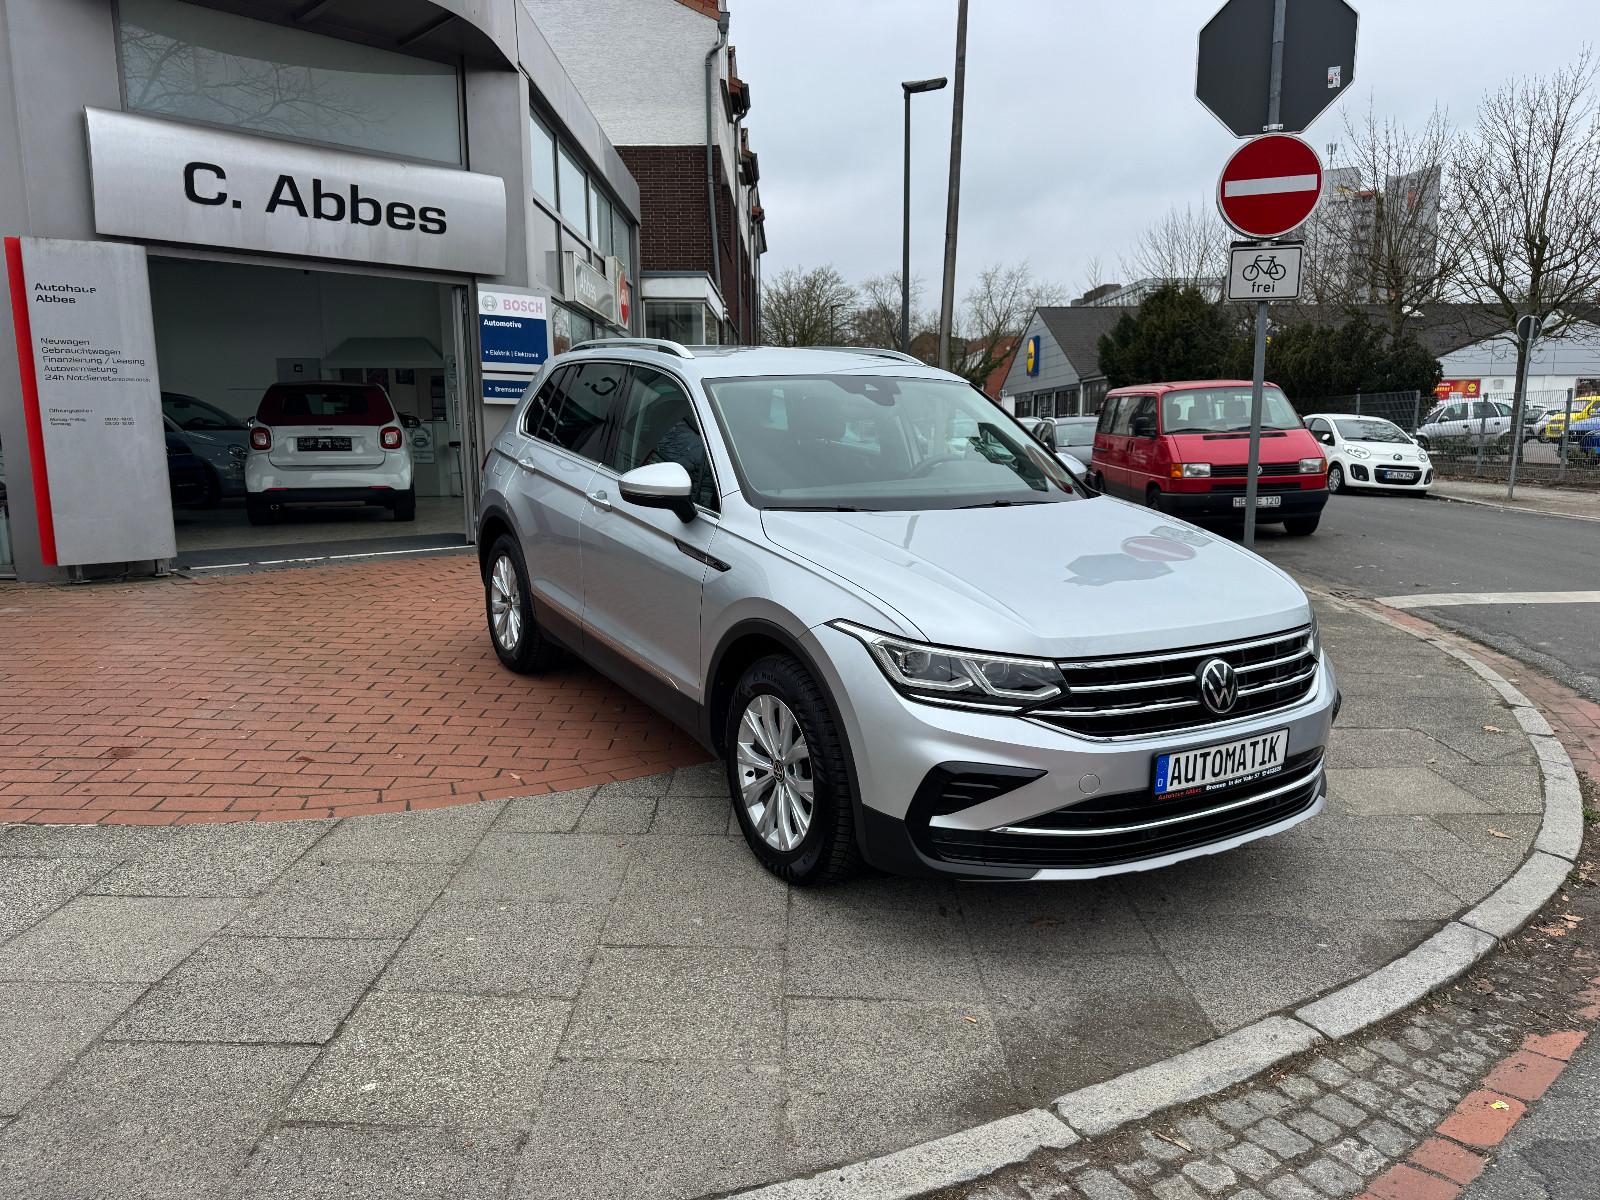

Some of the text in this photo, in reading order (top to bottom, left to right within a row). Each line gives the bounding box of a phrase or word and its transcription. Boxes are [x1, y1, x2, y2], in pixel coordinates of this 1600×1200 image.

[184, 162, 447, 234] C. Abbes
[1252, 281, 1275, 293] frei
[35, 294, 76, 304] Abbes
[503, 299, 543, 313] BOSCH
[483, 319, 522, 328] Automotive
[41, 337, 90, 346] Neuwagen
[42, 347, 121, 356] Gebrauchtwagen
[489, 349, 510, 357] Elektrik
[43, 356, 103, 365] Finanzierung
[112, 358, 145, 367] Leasing
[44, 365, 118, 374] Autovermietung
[66, 373, 113, 382] Notdienst
[1169, 734, 1281, 787] AUTOMATIK
